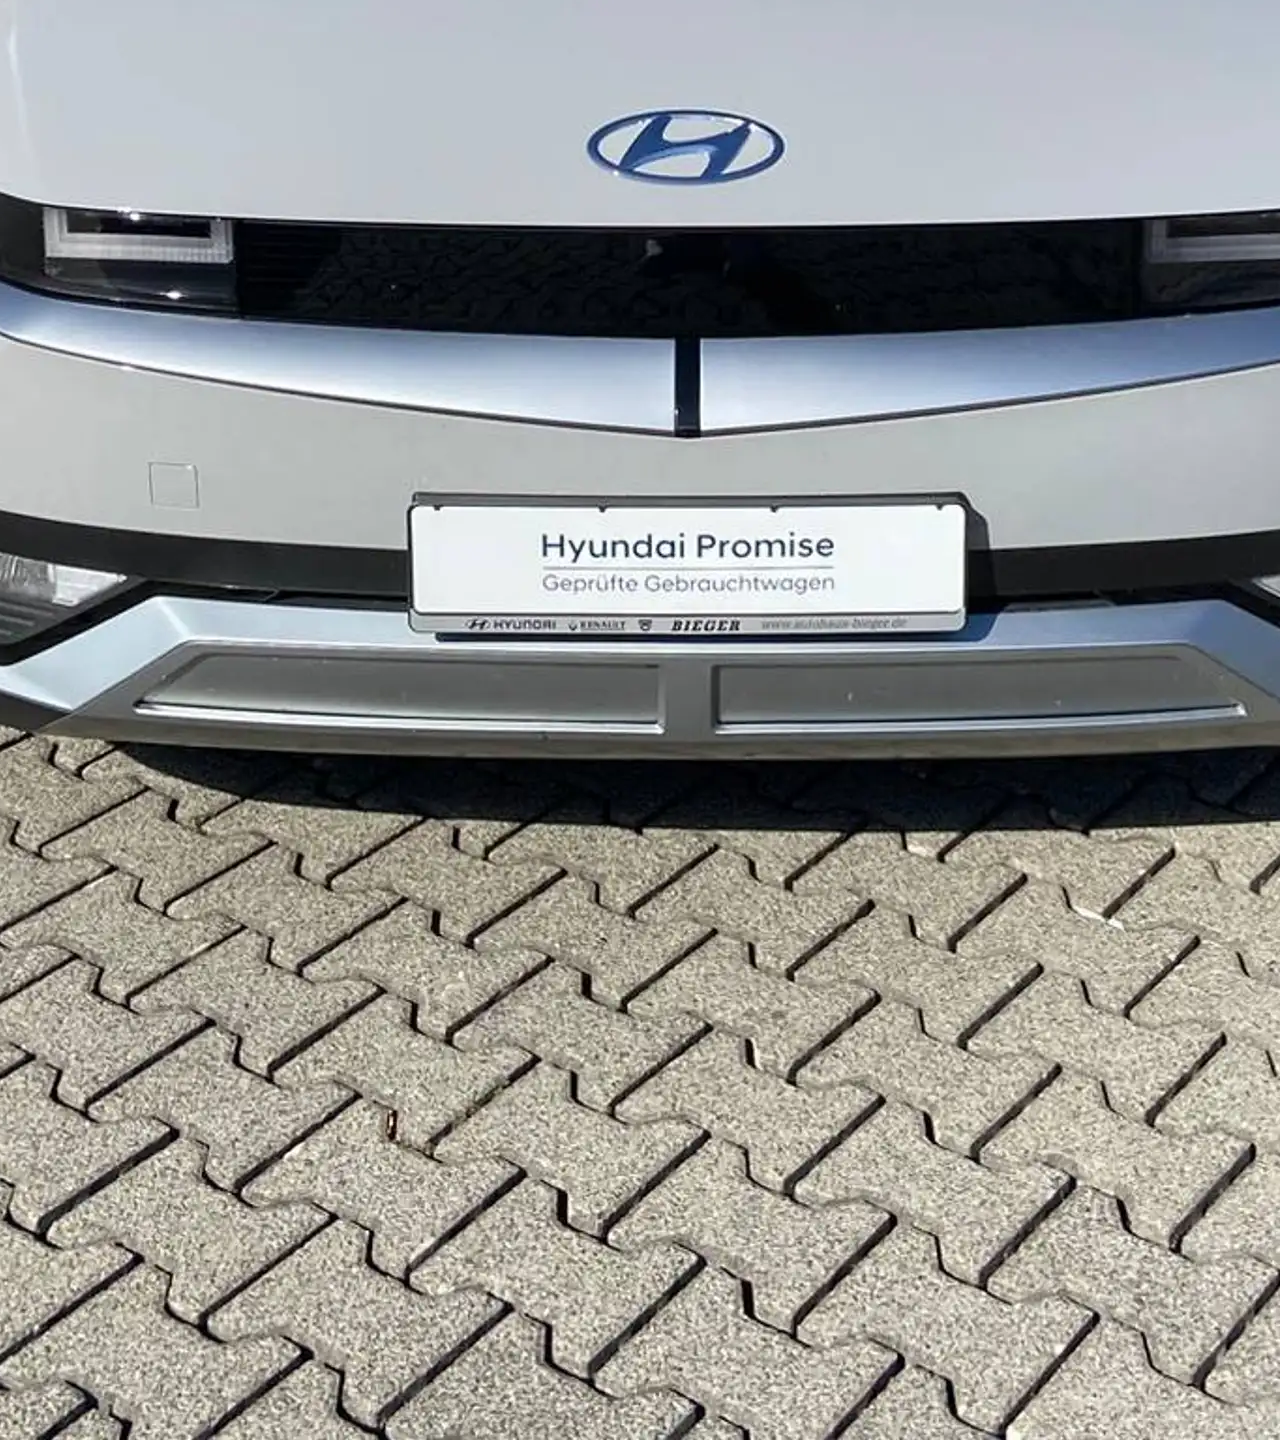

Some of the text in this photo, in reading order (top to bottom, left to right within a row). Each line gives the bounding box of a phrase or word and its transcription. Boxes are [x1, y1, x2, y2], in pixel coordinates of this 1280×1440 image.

[542, 531, 835, 565] Hyundai Promise
[542, 572, 835, 596] Geprüfte Gebrauchtwagen
[493, 619, 557, 631] HYUNDAI
[671, 620, 741, 632] BIEGER
